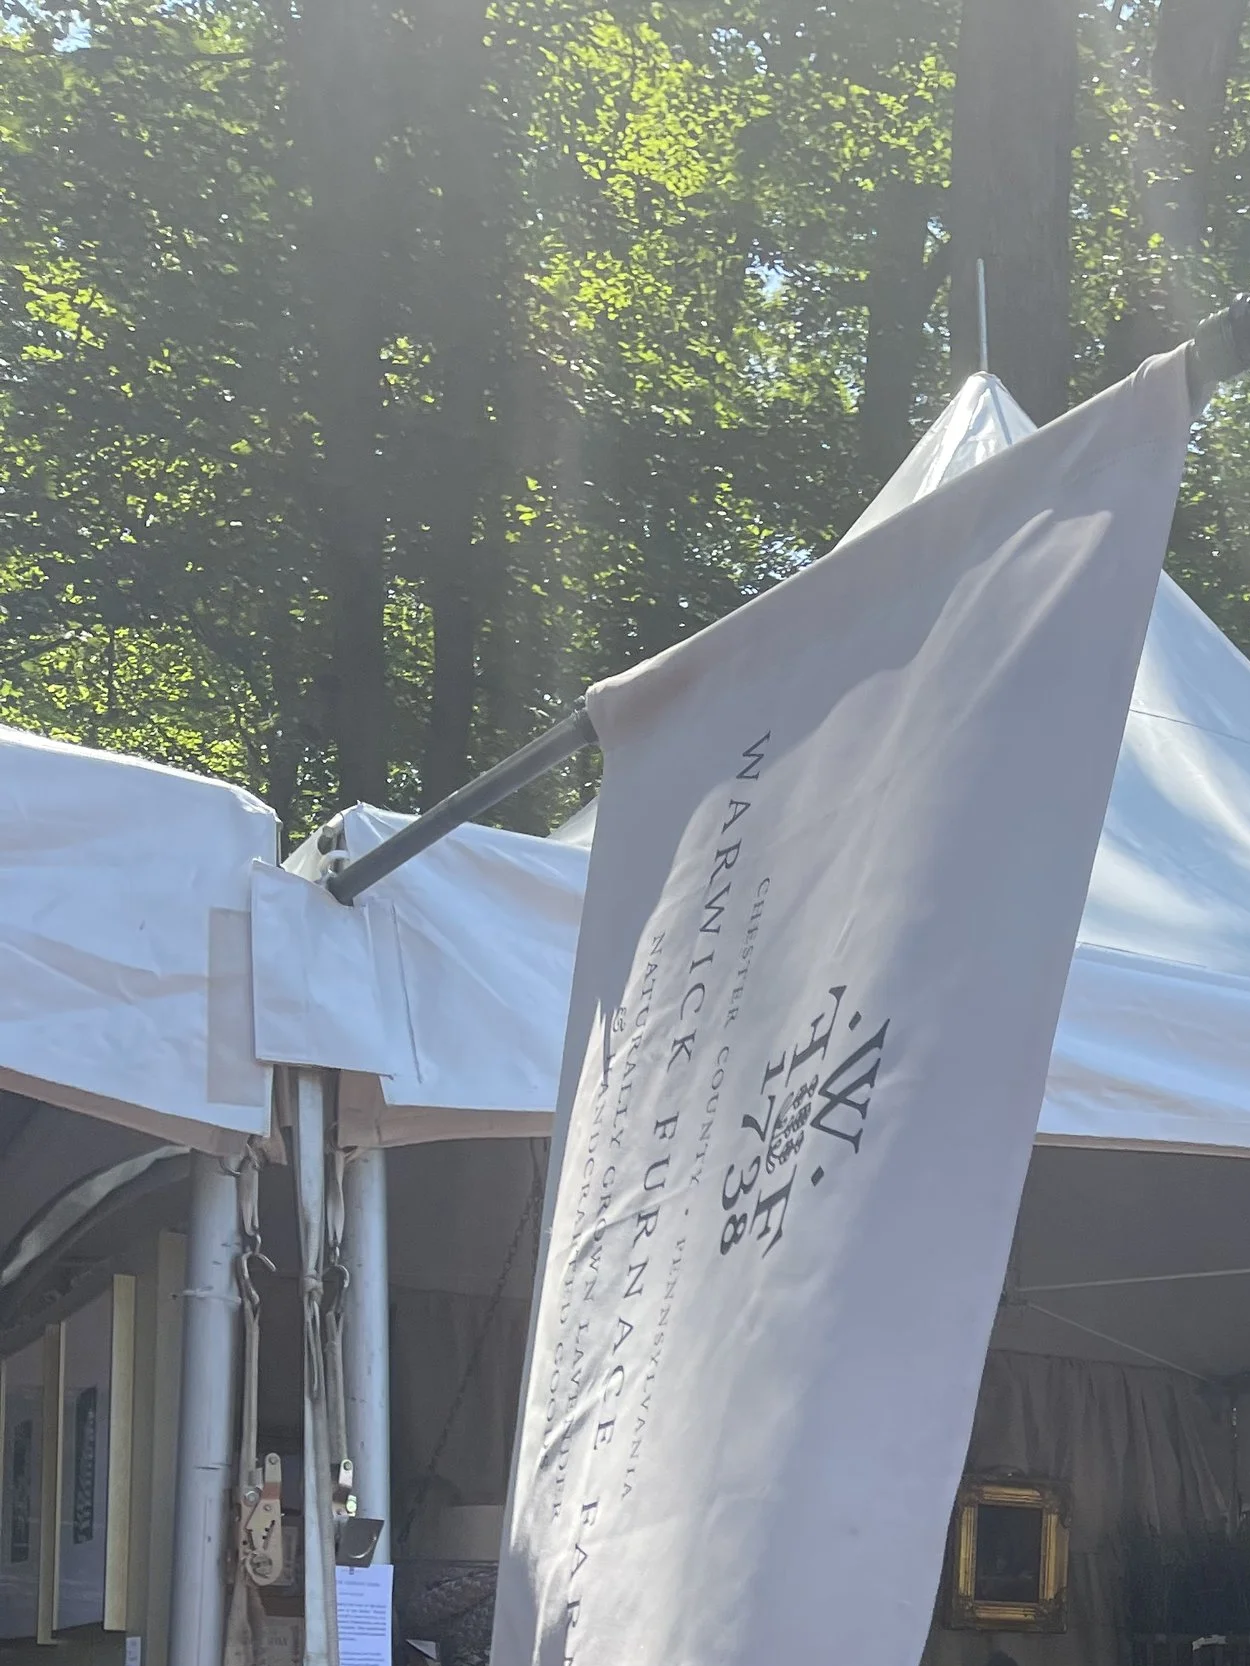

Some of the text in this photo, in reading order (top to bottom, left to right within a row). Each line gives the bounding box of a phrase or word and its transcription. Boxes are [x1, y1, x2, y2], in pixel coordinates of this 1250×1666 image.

[611, 931, 665, 1150] NATURALLY
[667, 729, 772, 1073] WARWICK
[583, 1165, 616, 1301] GROWN
[593, 1111, 680, 1450] FURNACE
[621, 877, 770, 1501] CHESTER COUNTY PENNSYLVANIA
